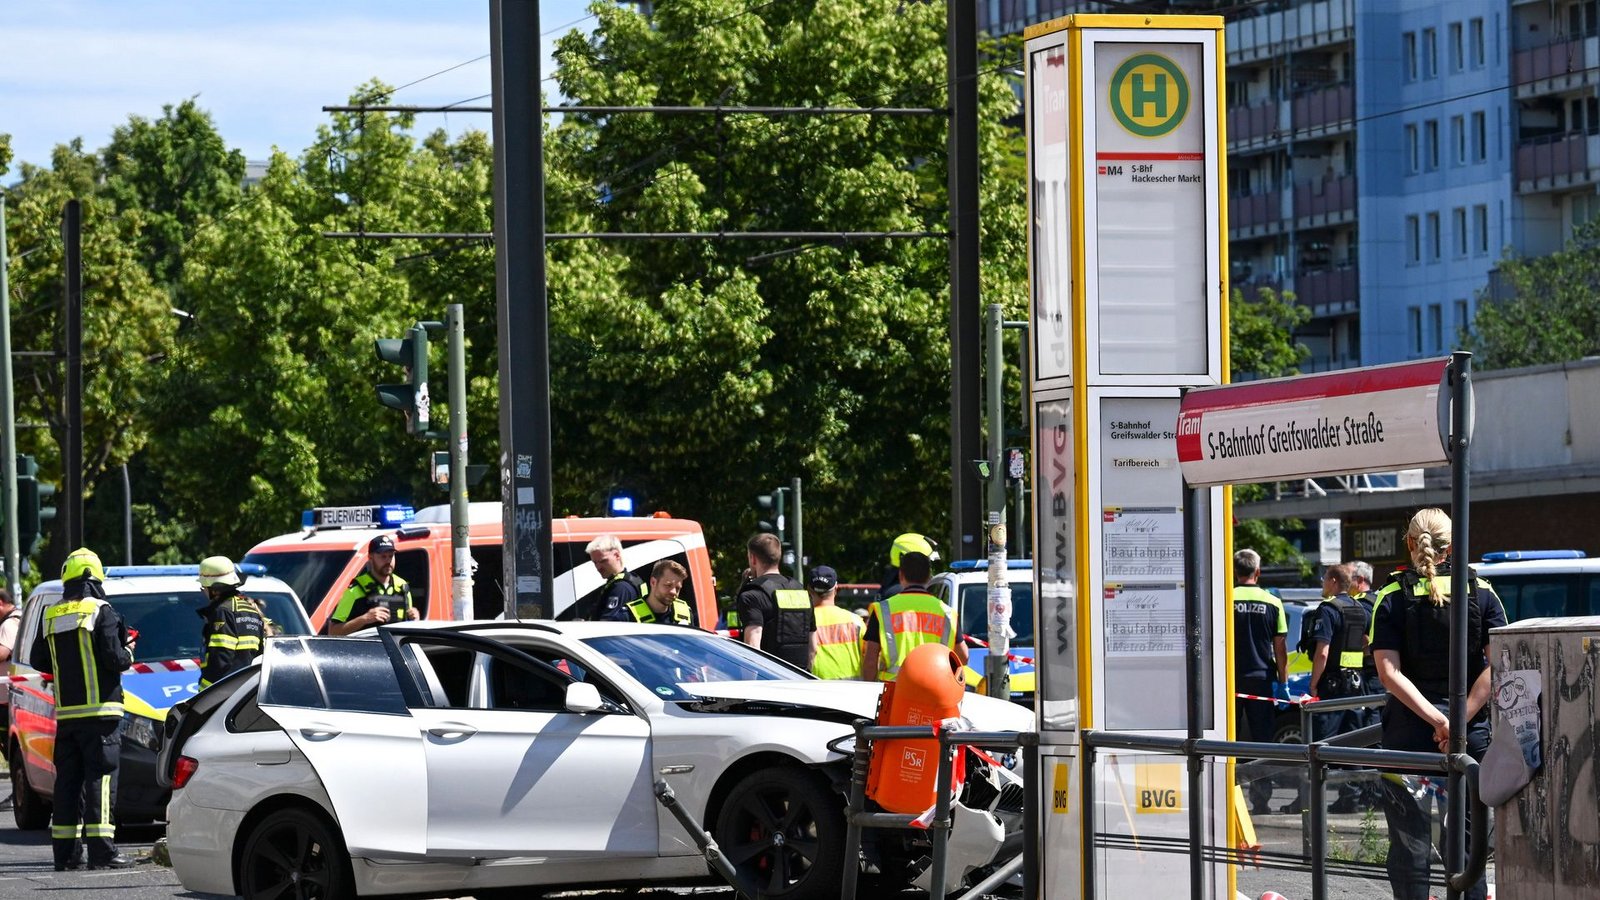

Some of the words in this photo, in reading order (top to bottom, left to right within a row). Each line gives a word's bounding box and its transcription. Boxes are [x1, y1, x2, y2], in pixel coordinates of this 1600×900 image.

[1131, 73, 1168, 118] H
[1107, 165, 1123, 176] M4
[1131, 164, 1153, 173] S-Bhf
[1131, 174, 1176, 183] Hackescher
[1177, 174, 1202, 183] Markt
[1110, 420, 1151, 430] S-Bahnhof
[1178, 412, 1201, 437] Tram
[1110, 431, 1161, 440] Greifswalder
[1207, 424, 1266, 460] S-Bahnhof
[1267, 417, 1341, 454] Greifswalder
[1343, 411, 1385, 446] Straße
[1113, 459, 1160, 468] Tarifbereich
[322, 508, 372, 524] FEUERWEHR
[1111, 546, 1185, 560] Baufahrplan
[1112, 622, 1186, 636] Baufahrplan
[904, 751, 923, 768] BSR
[1054, 790, 1067, 809] BVG
[1141, 789, 1177, 809] BVG
